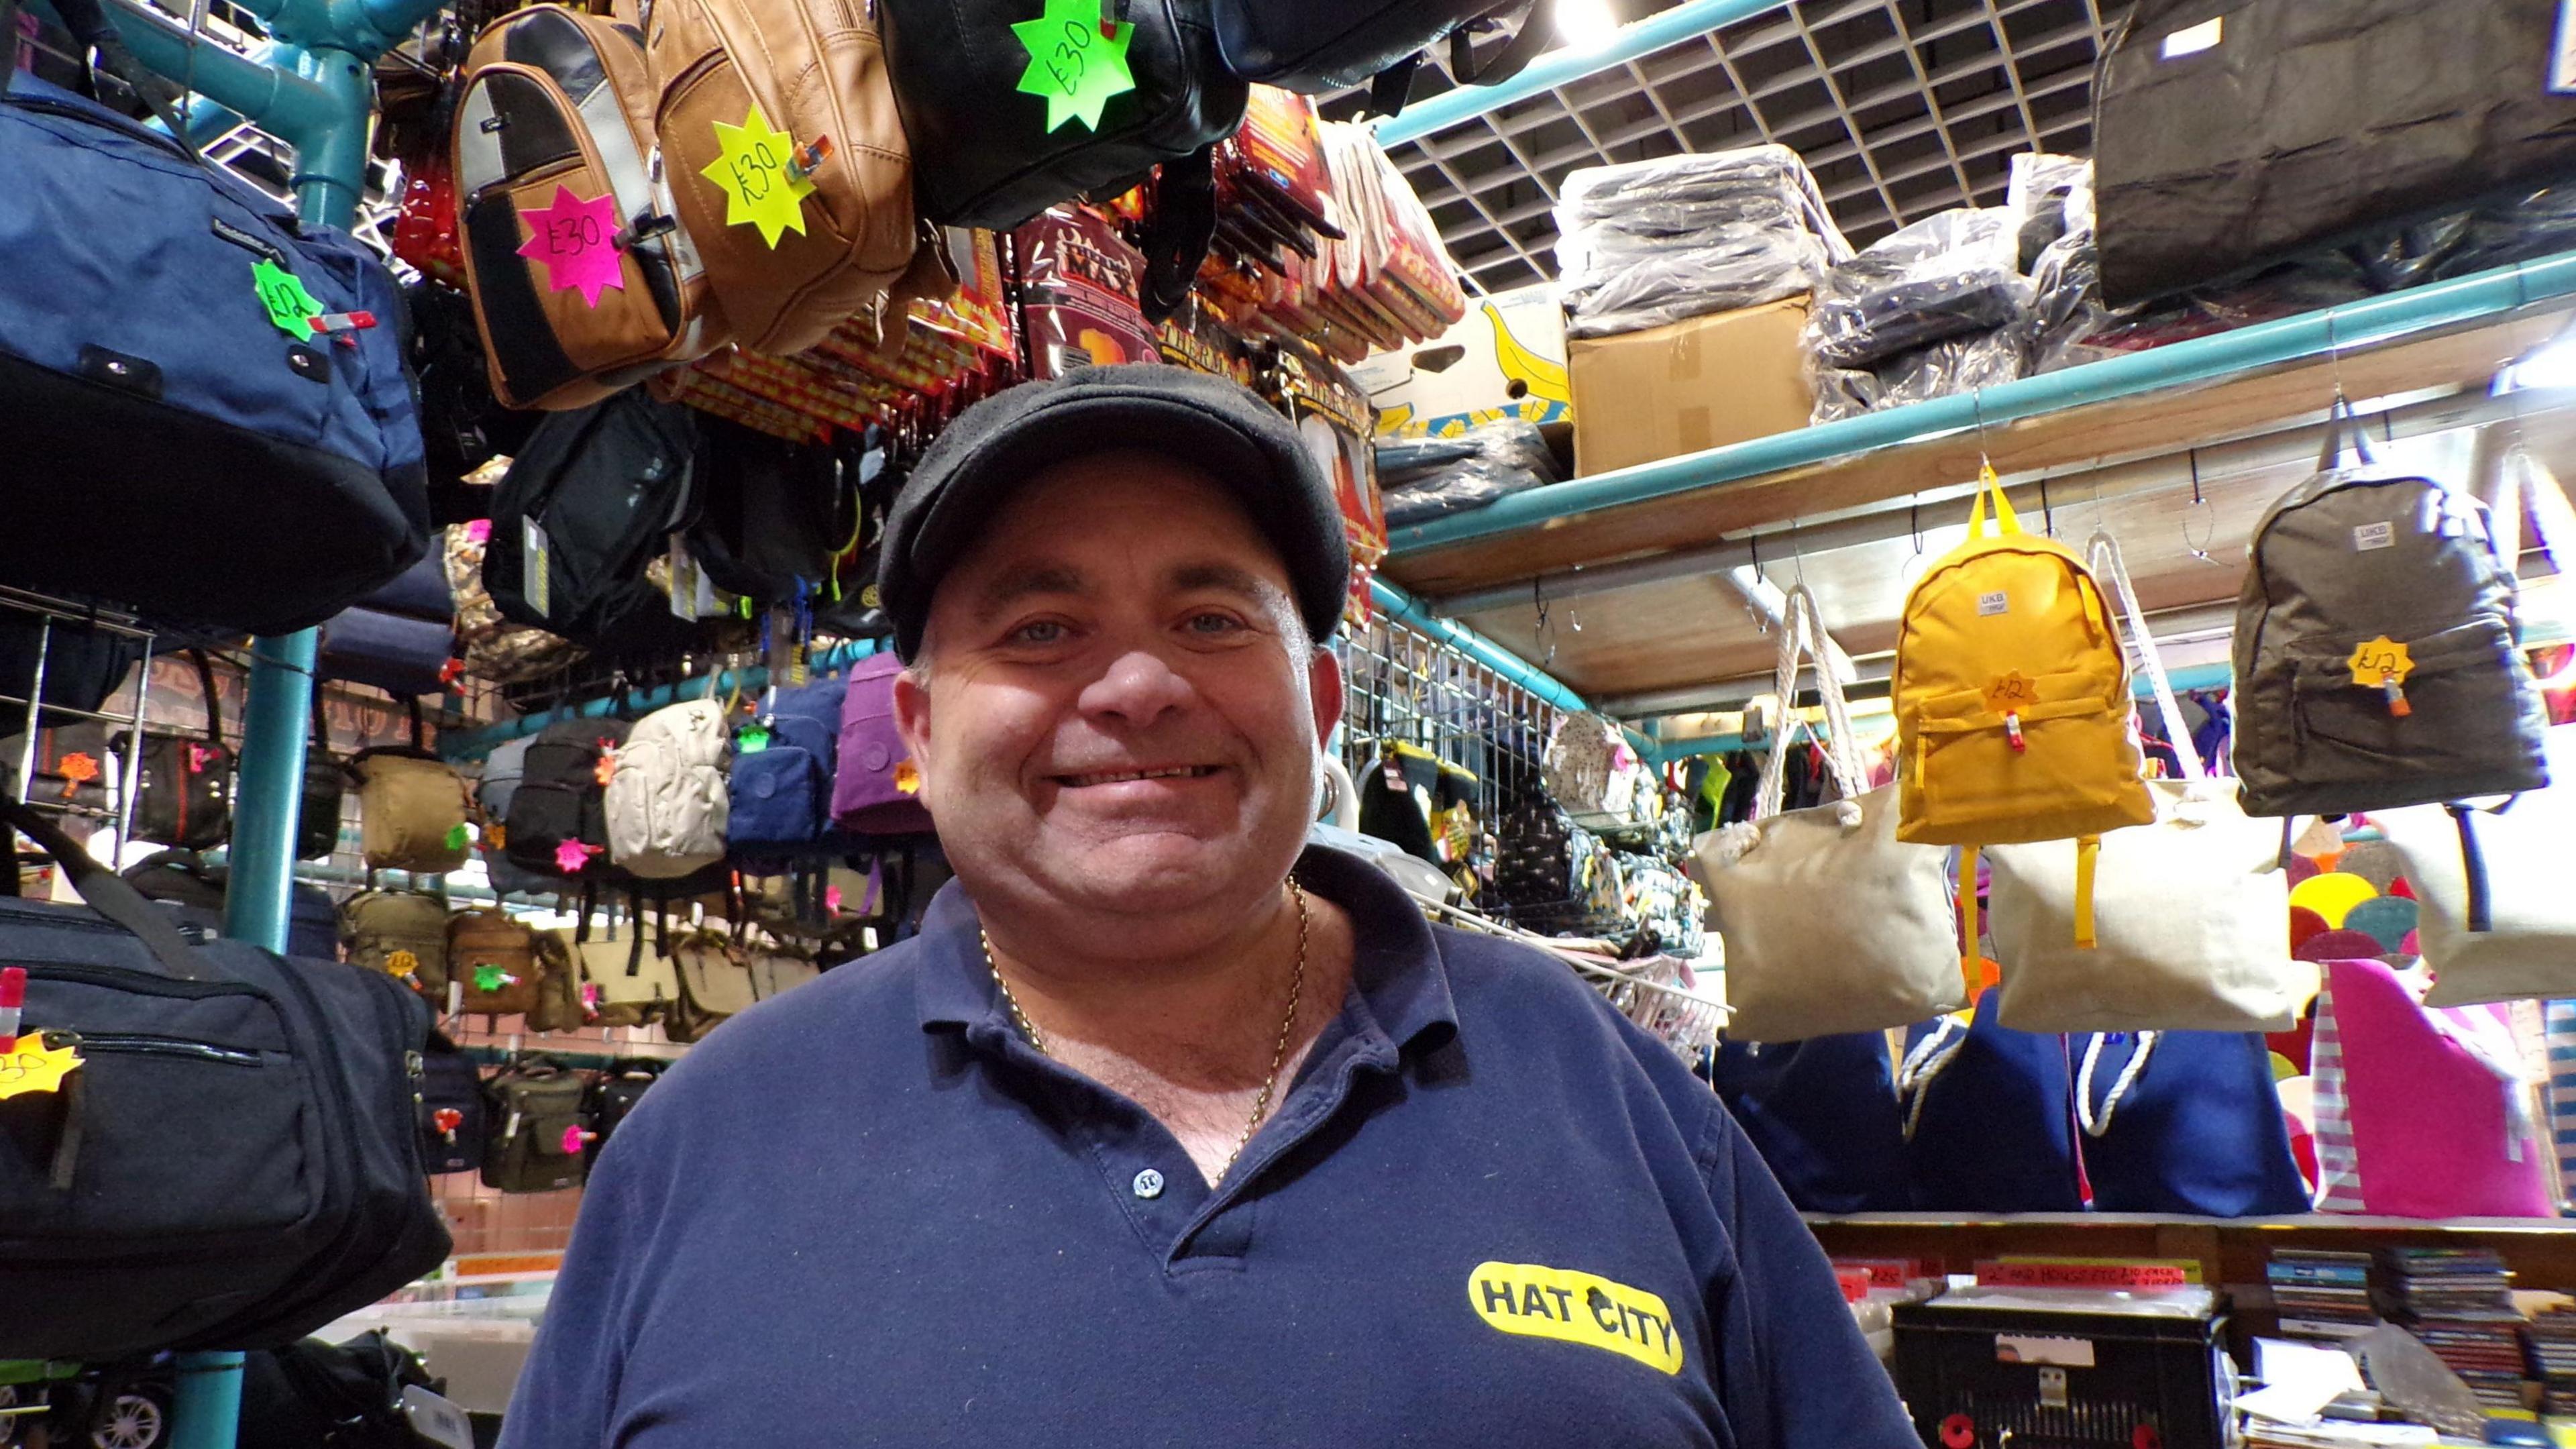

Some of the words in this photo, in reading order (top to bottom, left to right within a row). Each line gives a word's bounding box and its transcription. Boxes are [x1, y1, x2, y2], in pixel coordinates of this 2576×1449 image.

[1045, 20, 1090, 96] £30
[729, 142, 777, 207] £30
[546, 215, 600, 256] £30
[1067, 250, 1136, 299] MAX
[262, 279, 314, 319] £12
[1981, 593, 2004, 604] UKB
[2357, 647, 2403, 674] £12
[1992, 679, 2025, 699] £12
[1481, 1279, 1572, 1322] HAT
[1587, 1286, 1672, 1356] CITY
